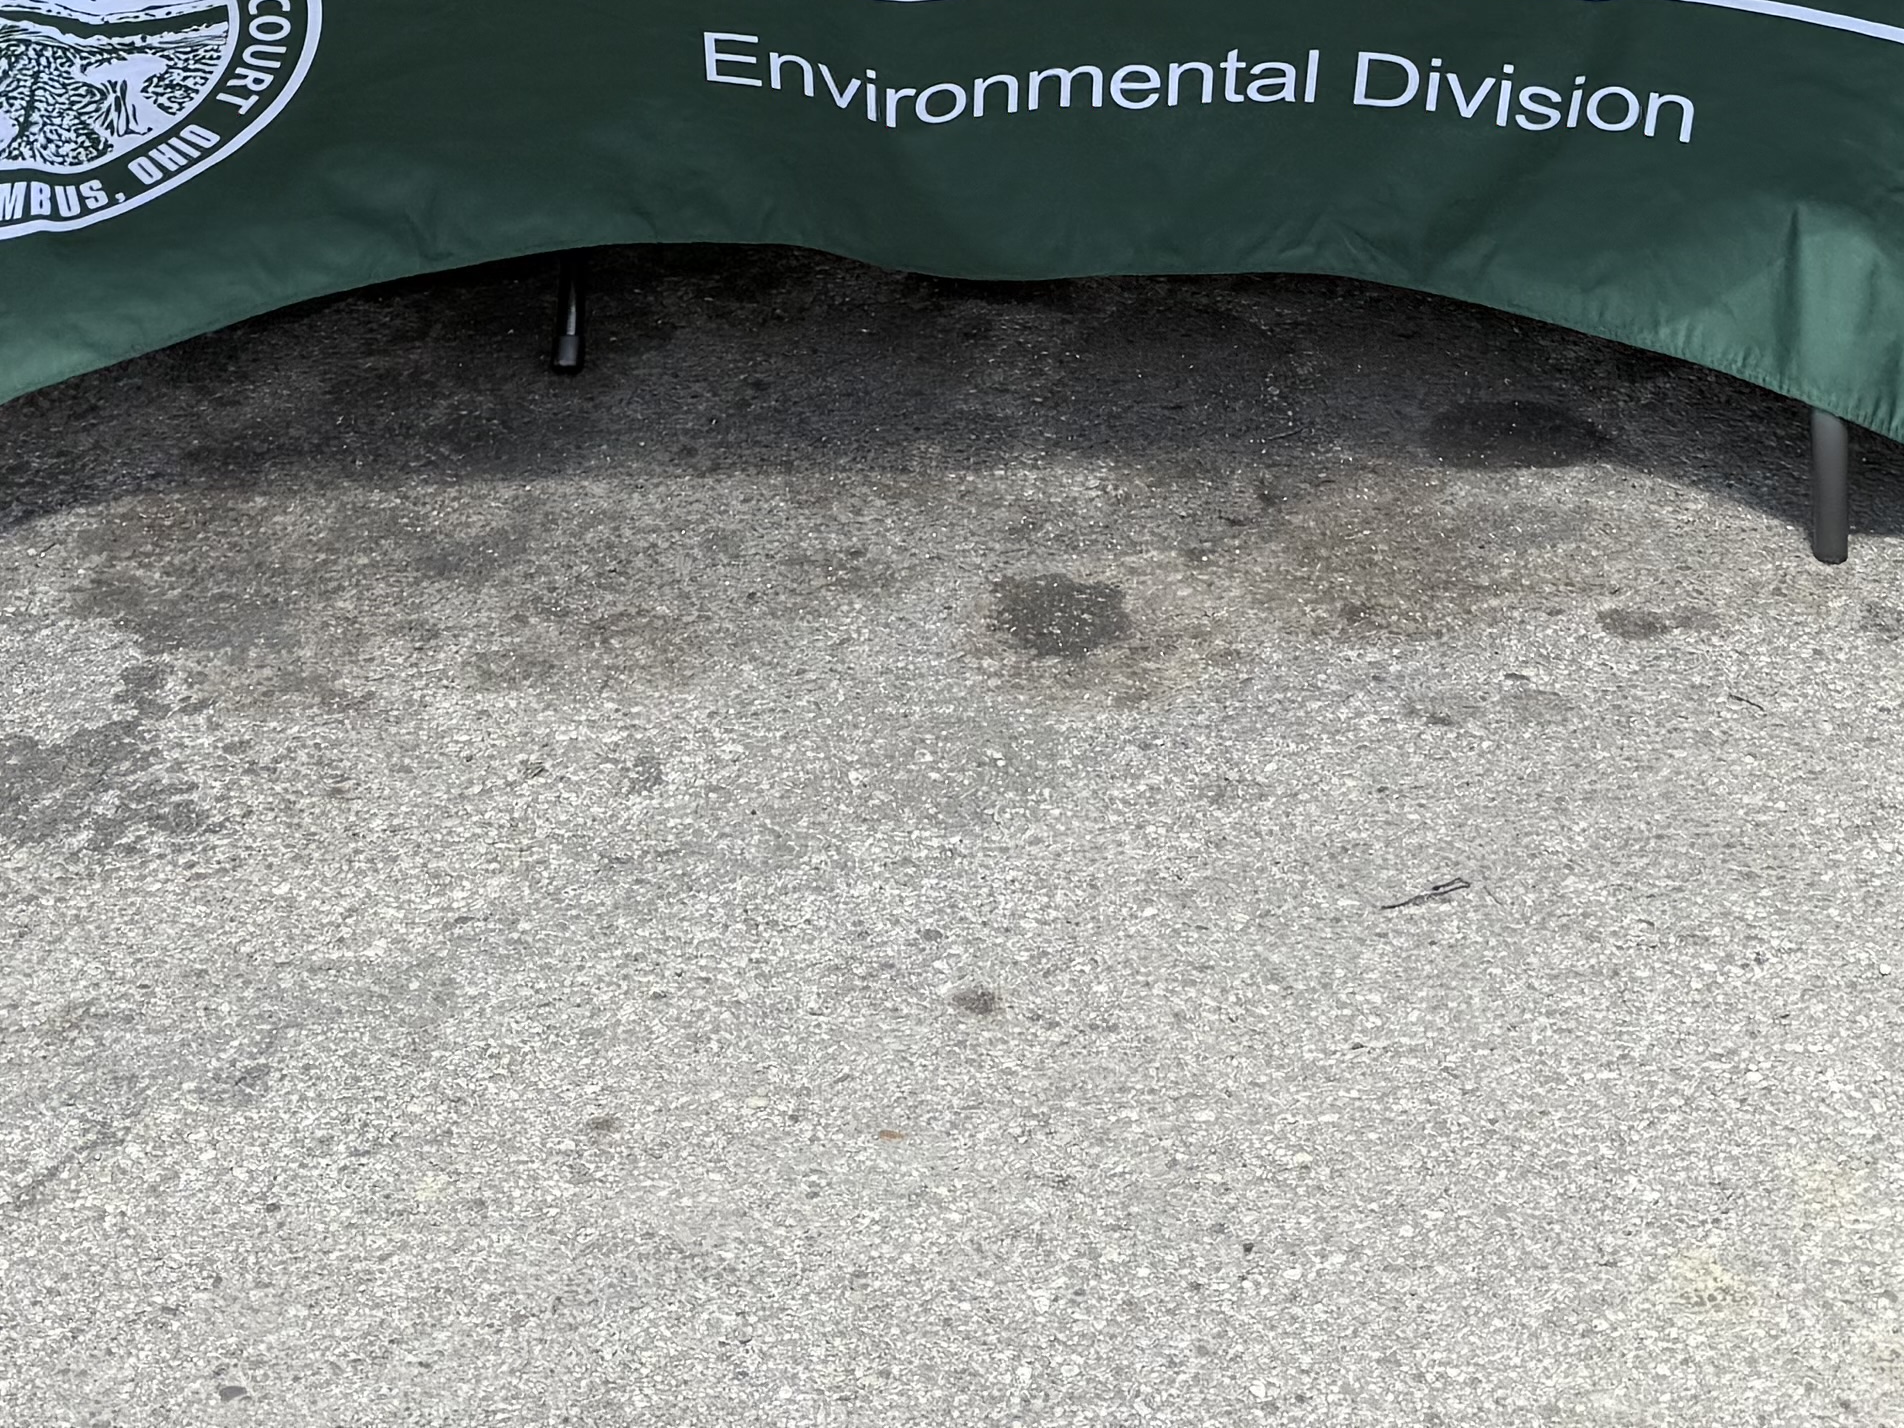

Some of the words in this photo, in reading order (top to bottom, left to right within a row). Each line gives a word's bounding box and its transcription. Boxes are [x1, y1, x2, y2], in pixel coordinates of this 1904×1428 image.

[702, 30, 1320, 129] Environmental
[1351, 50, 1696, 144] Division
[127, 121, 222, 186] OHIO
